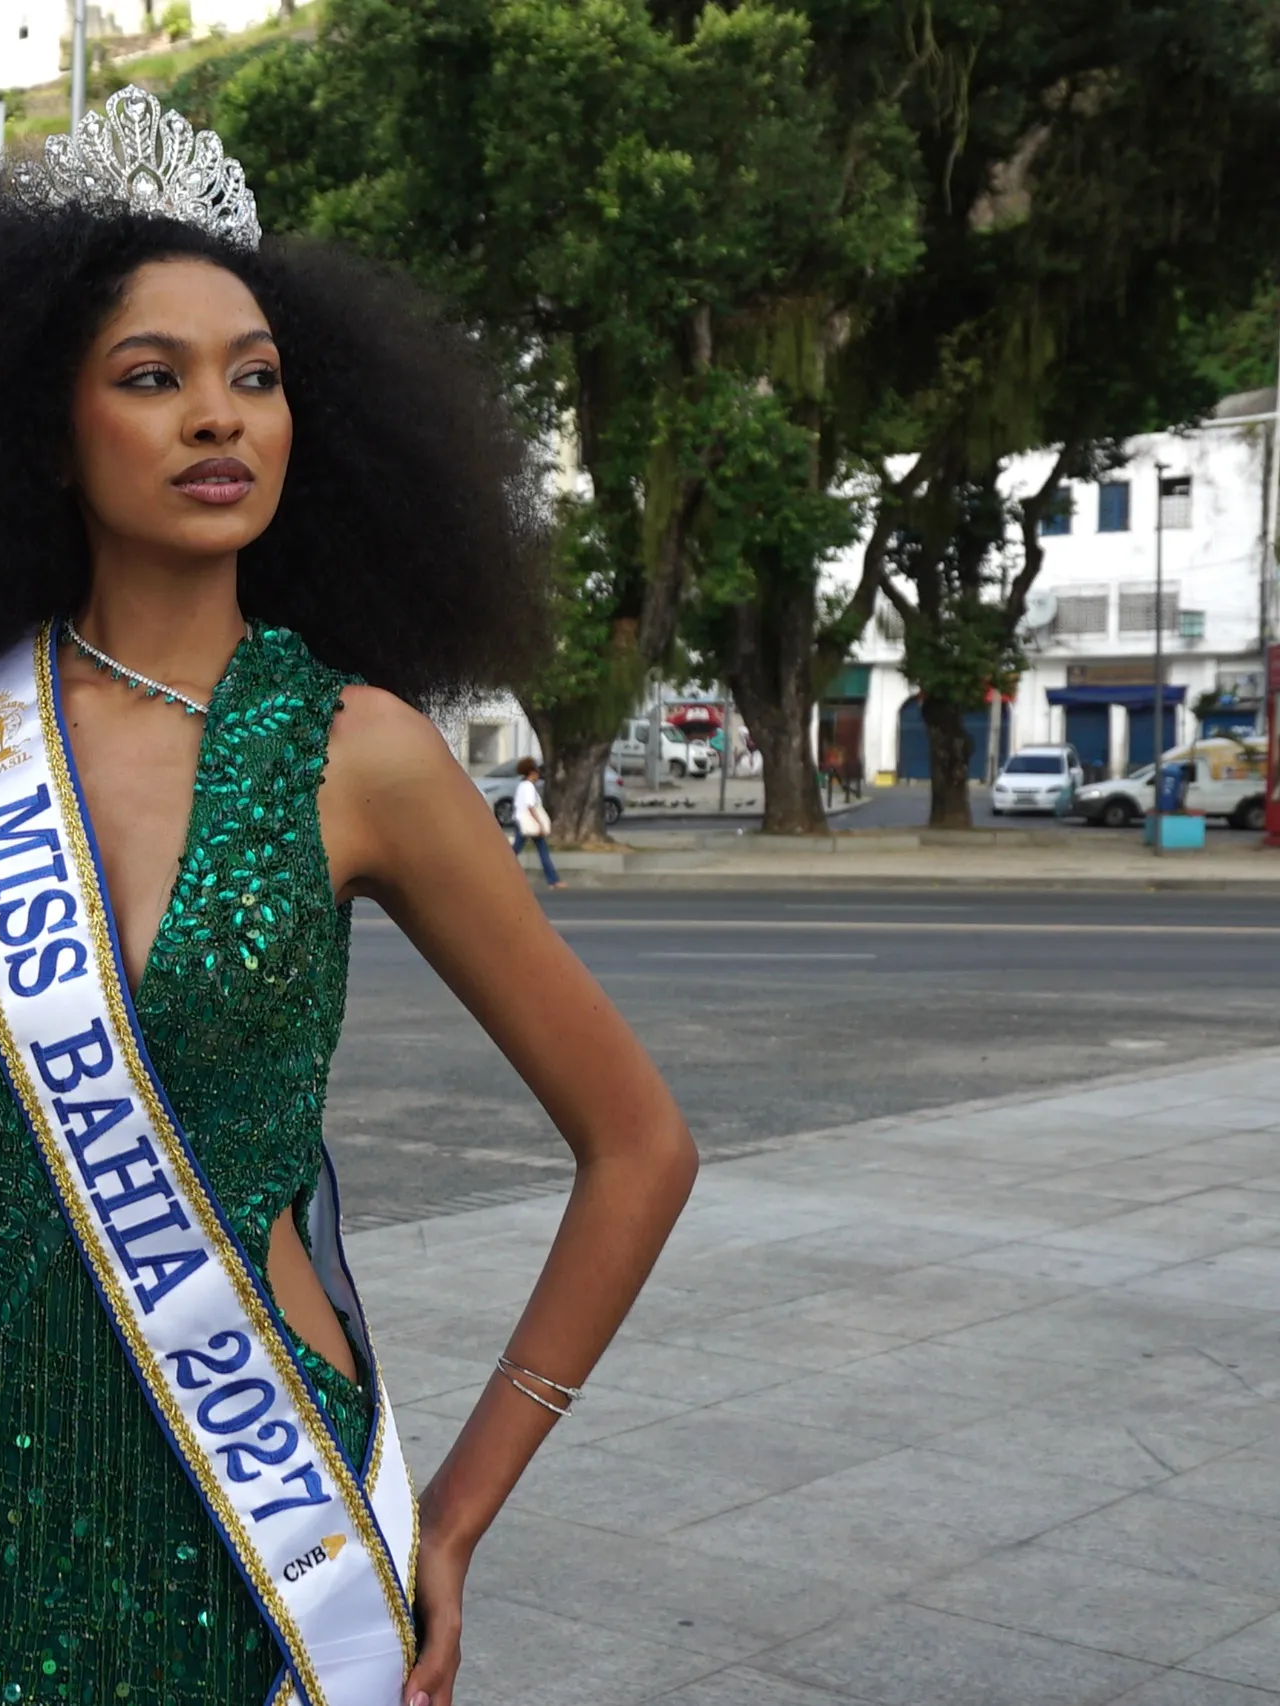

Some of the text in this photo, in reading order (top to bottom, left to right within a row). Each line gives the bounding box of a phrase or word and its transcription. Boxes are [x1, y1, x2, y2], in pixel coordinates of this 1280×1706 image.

[30, 1017, 210, 1315] BAHIA
[167, 1330, 333, 1524] 2027
[283, 1545, 327, 1583] CNB
